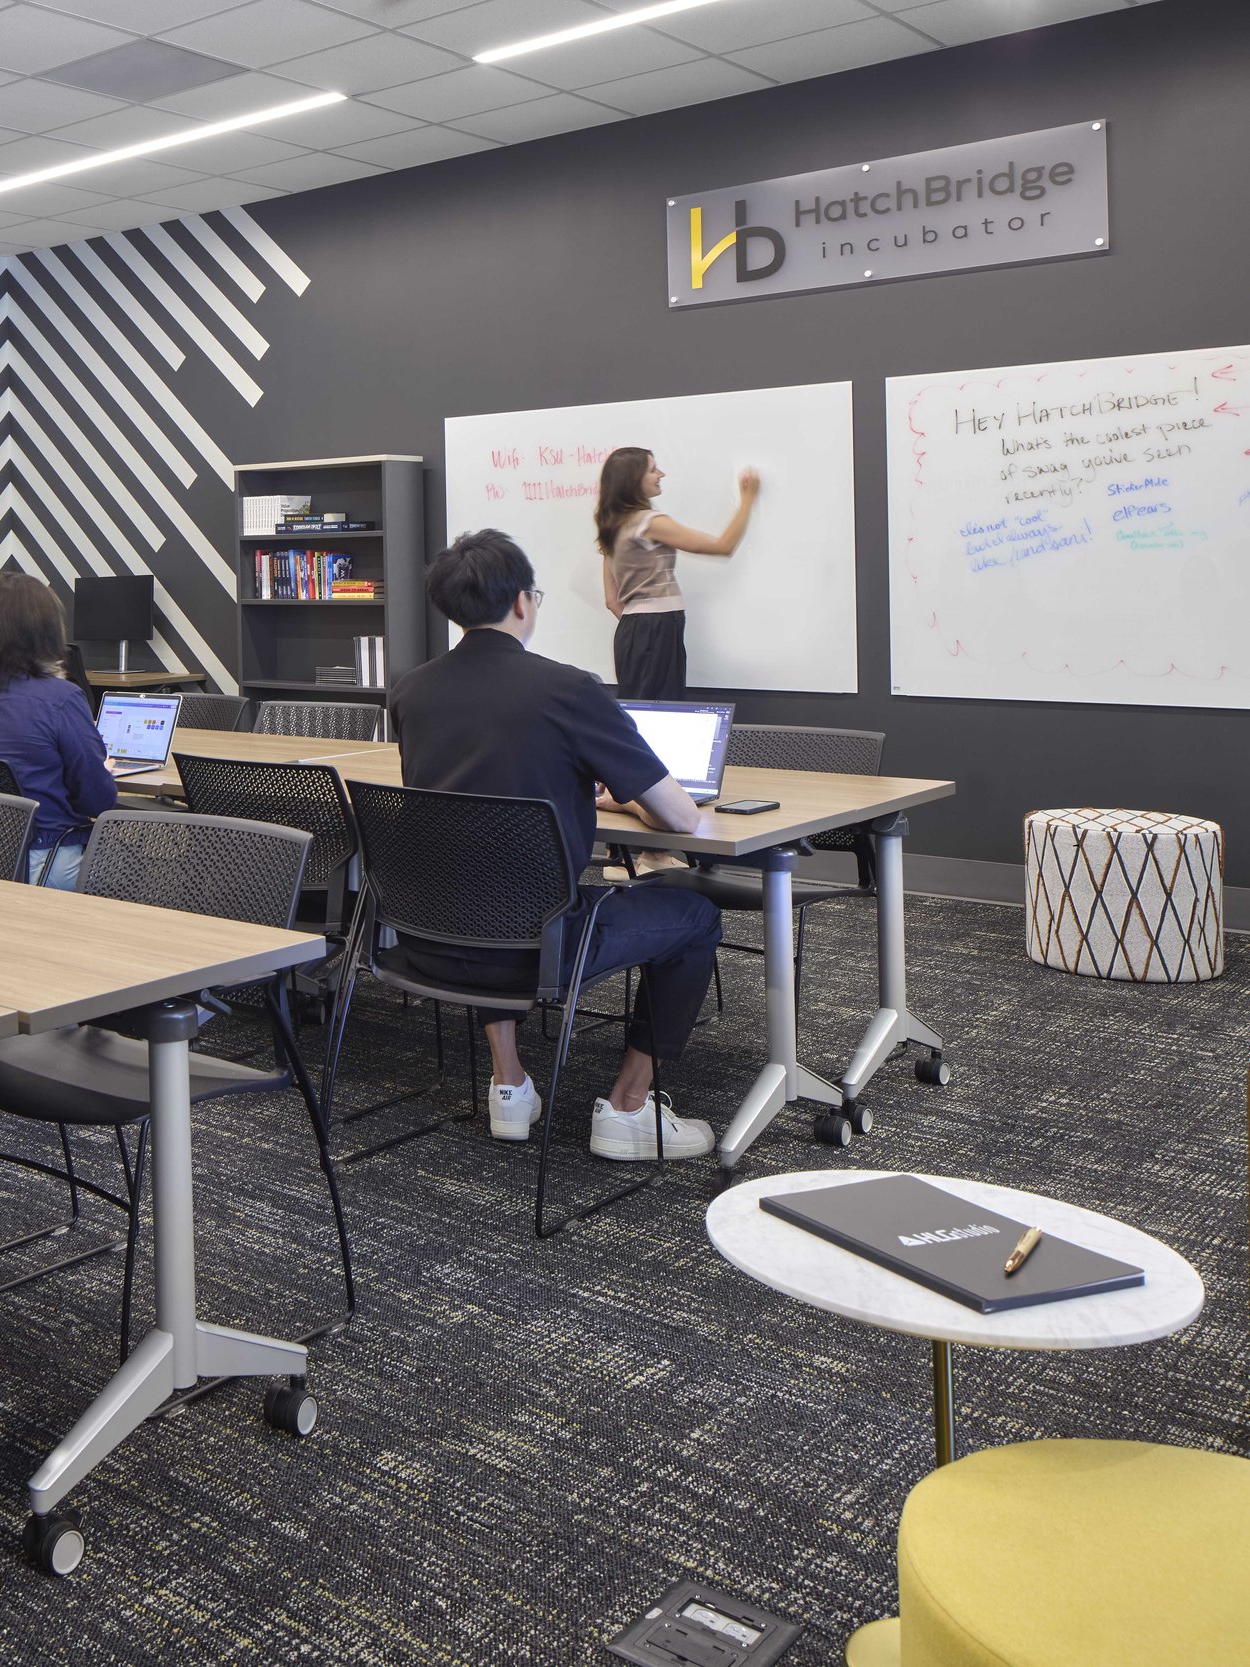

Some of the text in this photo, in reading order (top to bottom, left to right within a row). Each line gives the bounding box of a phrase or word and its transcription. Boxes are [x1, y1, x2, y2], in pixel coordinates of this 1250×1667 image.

[794, 160, 1075, 228] HatchBridge
[822, 208, 1052, 259] incubator
[955, 408, 1006, 434] HEY
[1001, 418, 1211, 457] What's the coolest piece
[999, 463, 1019, 481] of
[1022, 461, 1070, 483] swag
[1142, 443, 1192, 463] seen
